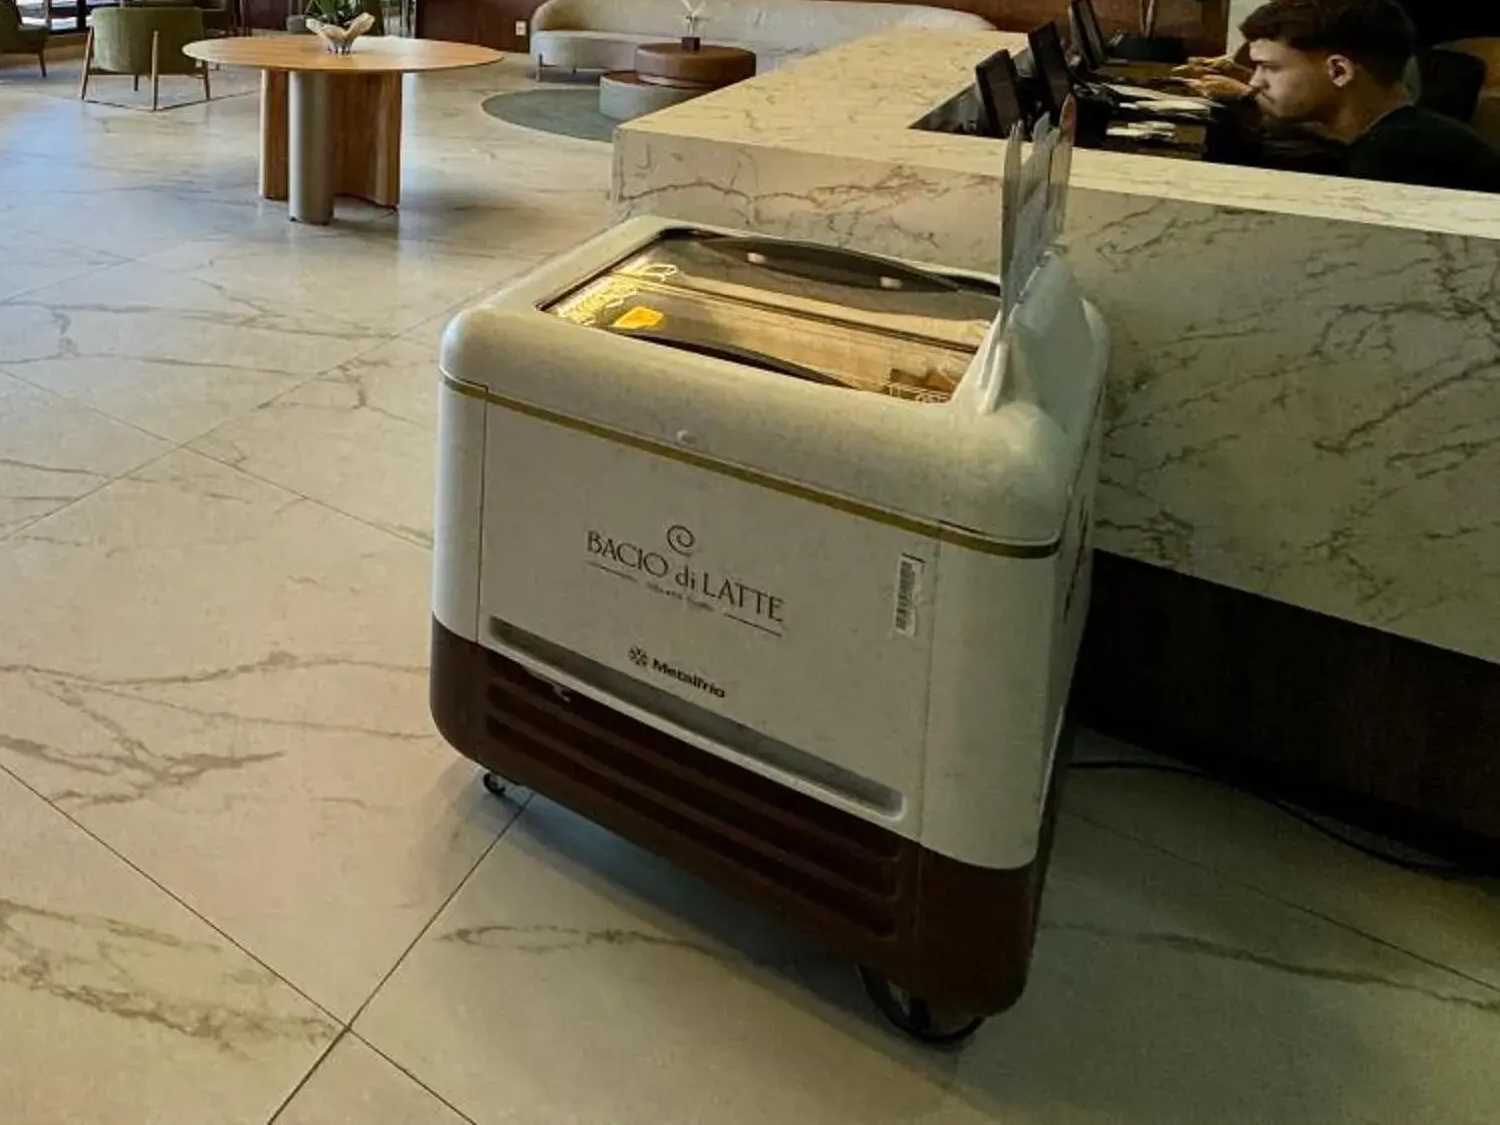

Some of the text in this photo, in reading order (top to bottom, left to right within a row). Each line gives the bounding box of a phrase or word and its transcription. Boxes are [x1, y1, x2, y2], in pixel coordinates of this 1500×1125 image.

[587, 530, 669, 577] BACIO
[675, 564, 696, 590] di
[703, 572, 785, 622] LATTE
[652, 658, 725, 698] Metalfrio
